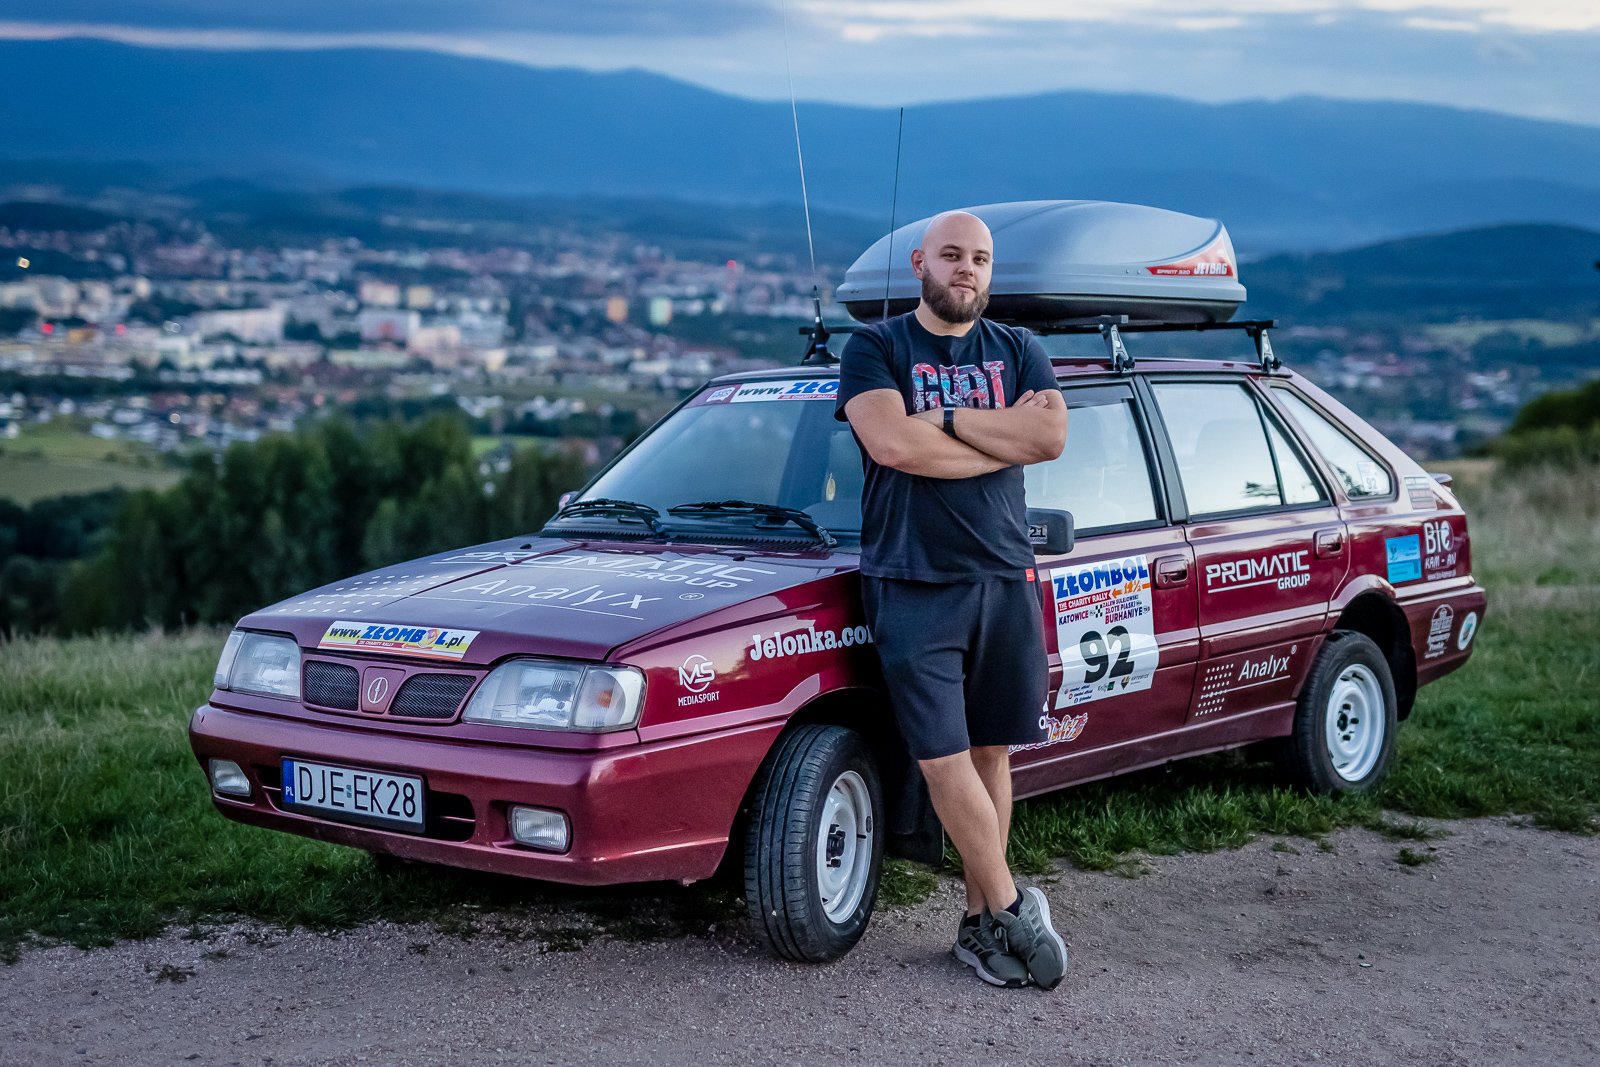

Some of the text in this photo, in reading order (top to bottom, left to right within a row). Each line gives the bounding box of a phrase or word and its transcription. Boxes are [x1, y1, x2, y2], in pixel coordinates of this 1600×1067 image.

[1194, 262, 1227, 275] JETBAG
[442, 550, 776, 582] PROMATIC
[1205, 550, 1310, 586] PROMATIC
[617, 570, 738, 588] GROUP
[1053, 556, 1148, 599] ZŁOMBOL
[1277, 573, 1311, 590] GROUP
[451, 579, 662, 609] Analyx
[1068, 597, 1091, 608] CHARITY
[1092, 591, 1108, 602] RALLY
[1120, 601, 1136, 610] PIASKI
[1058, 610, 1089, 625] KATOWICE
[1105, 606, 1142, 624] BURHANIYE
[1080, 625, 1134, 683] 92
[679, 661, 715, 685] MS
[1238, 654, 1290, 681] Analyx
[678, 691, 720, 707] MEDIASPORT
[285, 786, 294, 797] PL
[299, 766, 416, 818] DJE EK28
